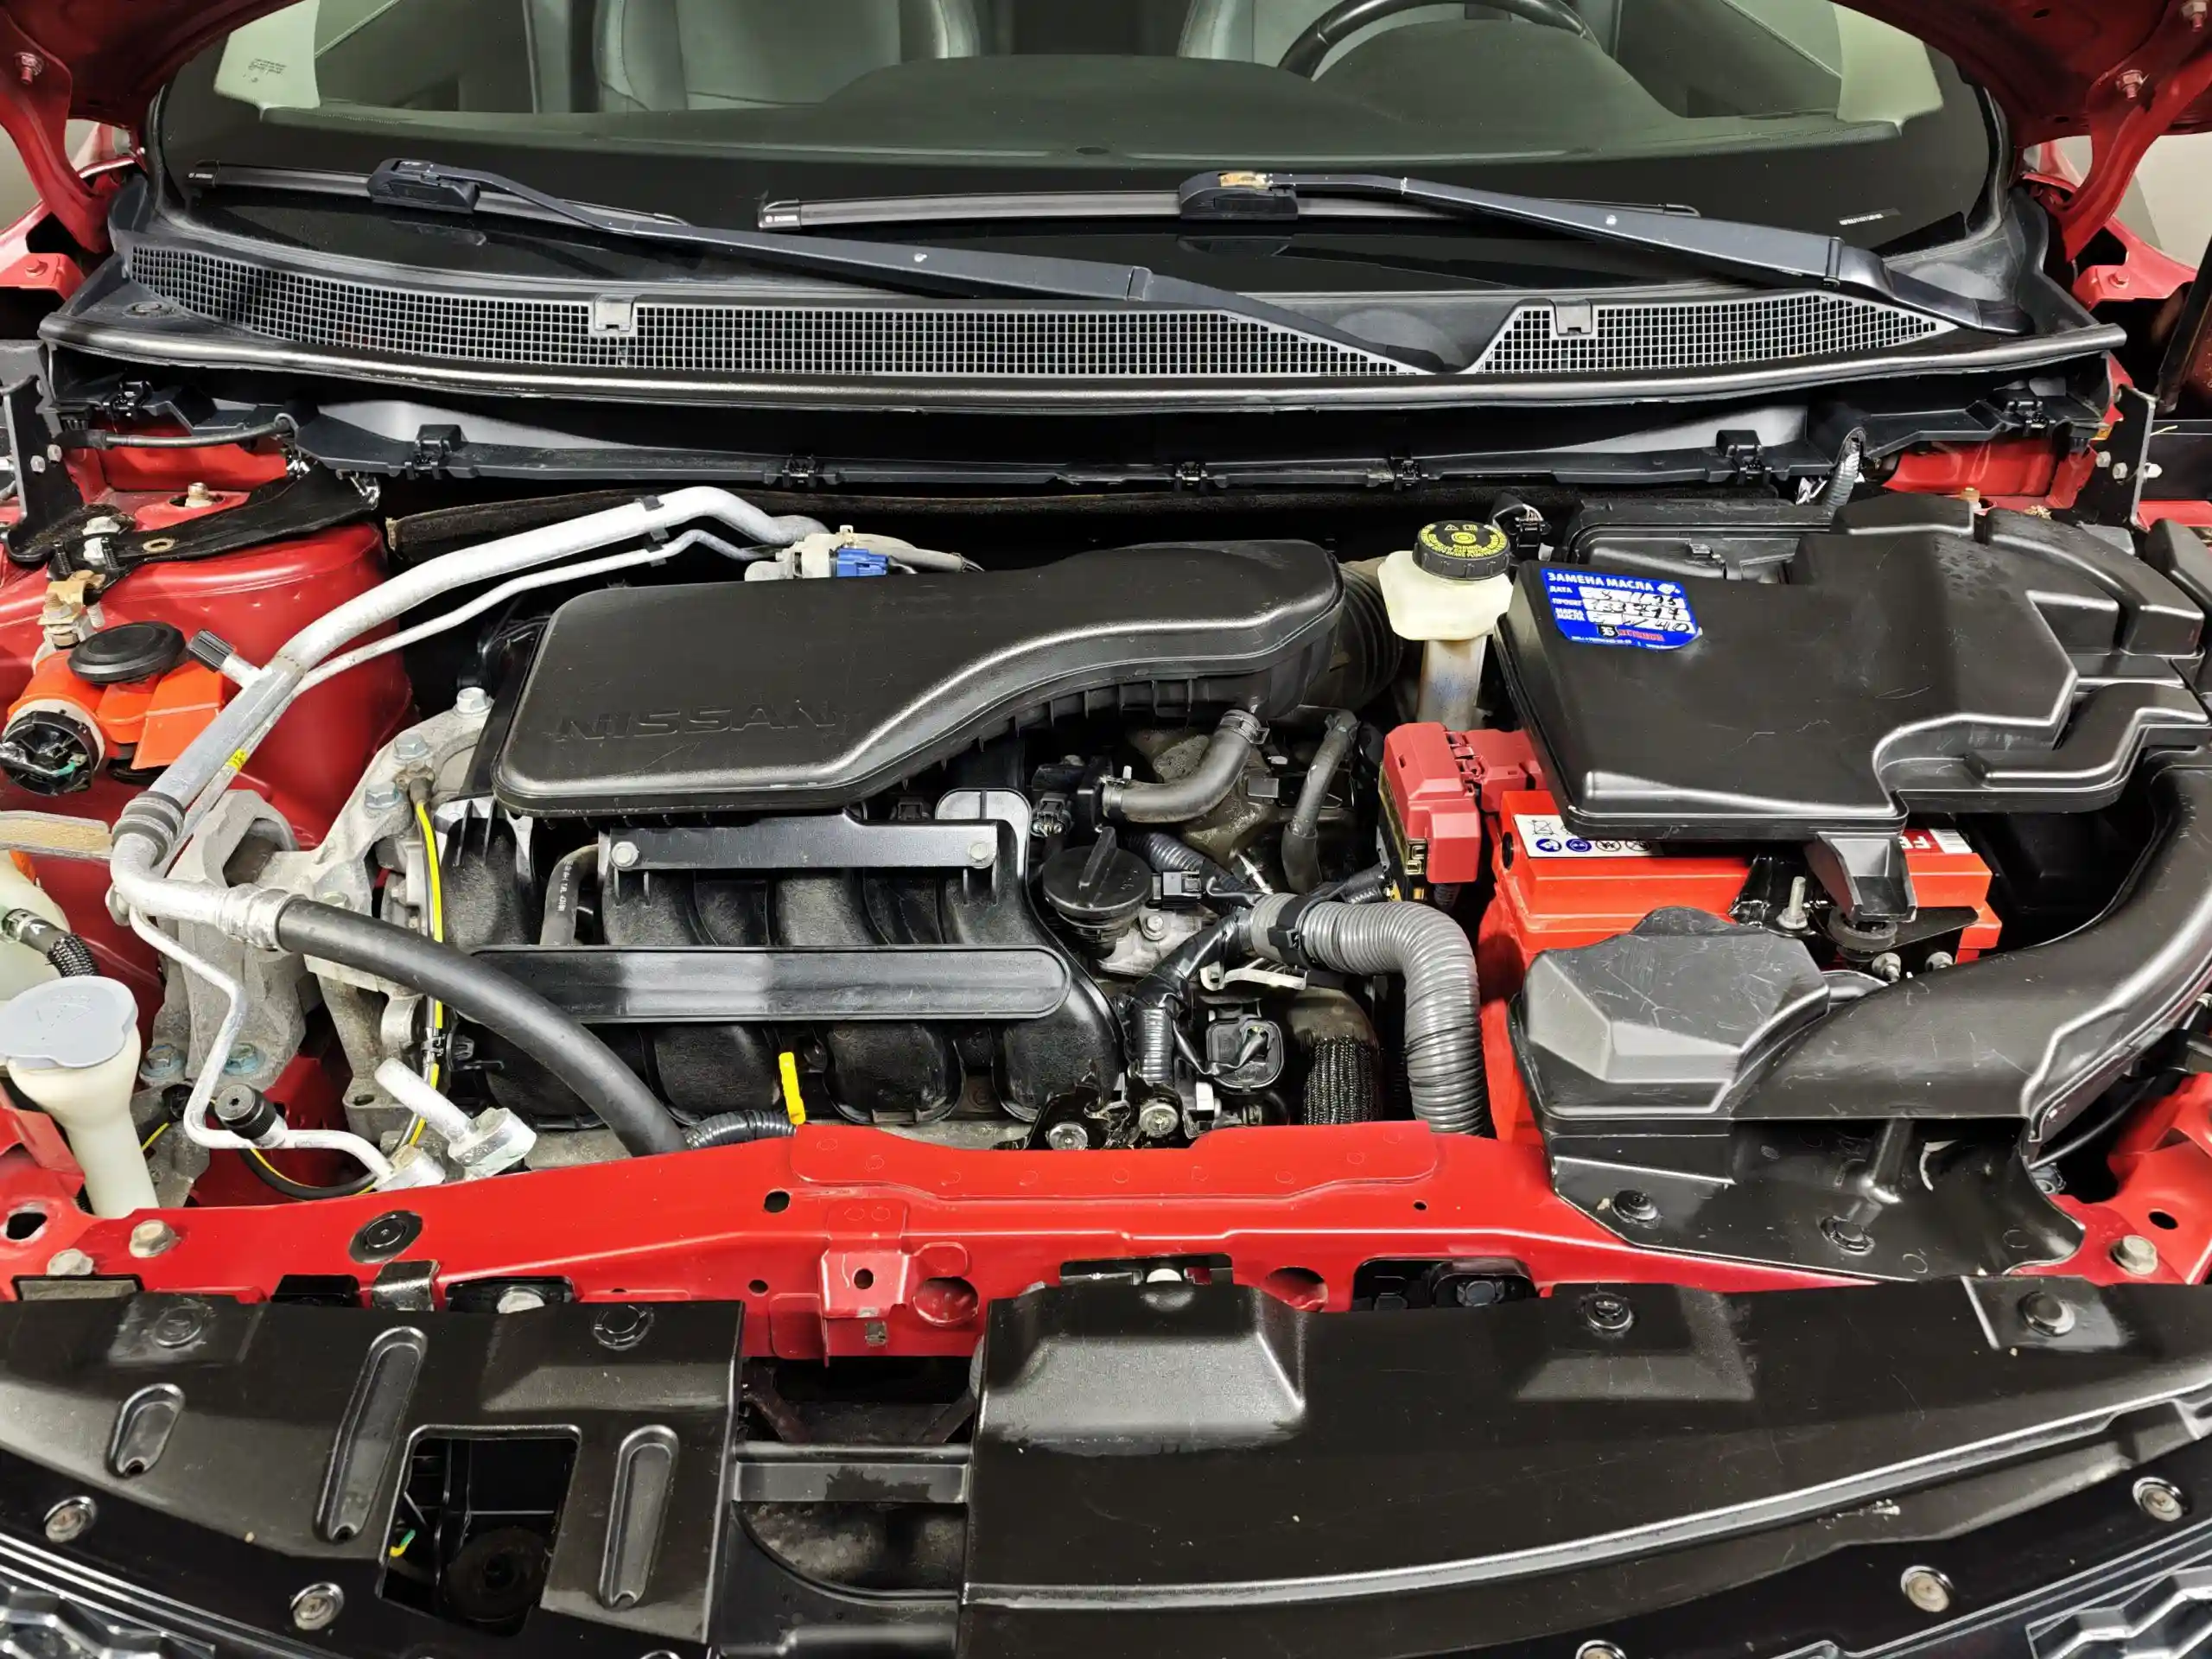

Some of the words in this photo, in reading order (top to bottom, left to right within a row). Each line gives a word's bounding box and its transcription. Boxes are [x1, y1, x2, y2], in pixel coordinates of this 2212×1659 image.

[1548, 572, 1605, 586] ЗАМЕНА
[1606, 578, 1655, 592] МАСЛА
[556, 703, 840, 742] NISSAN
